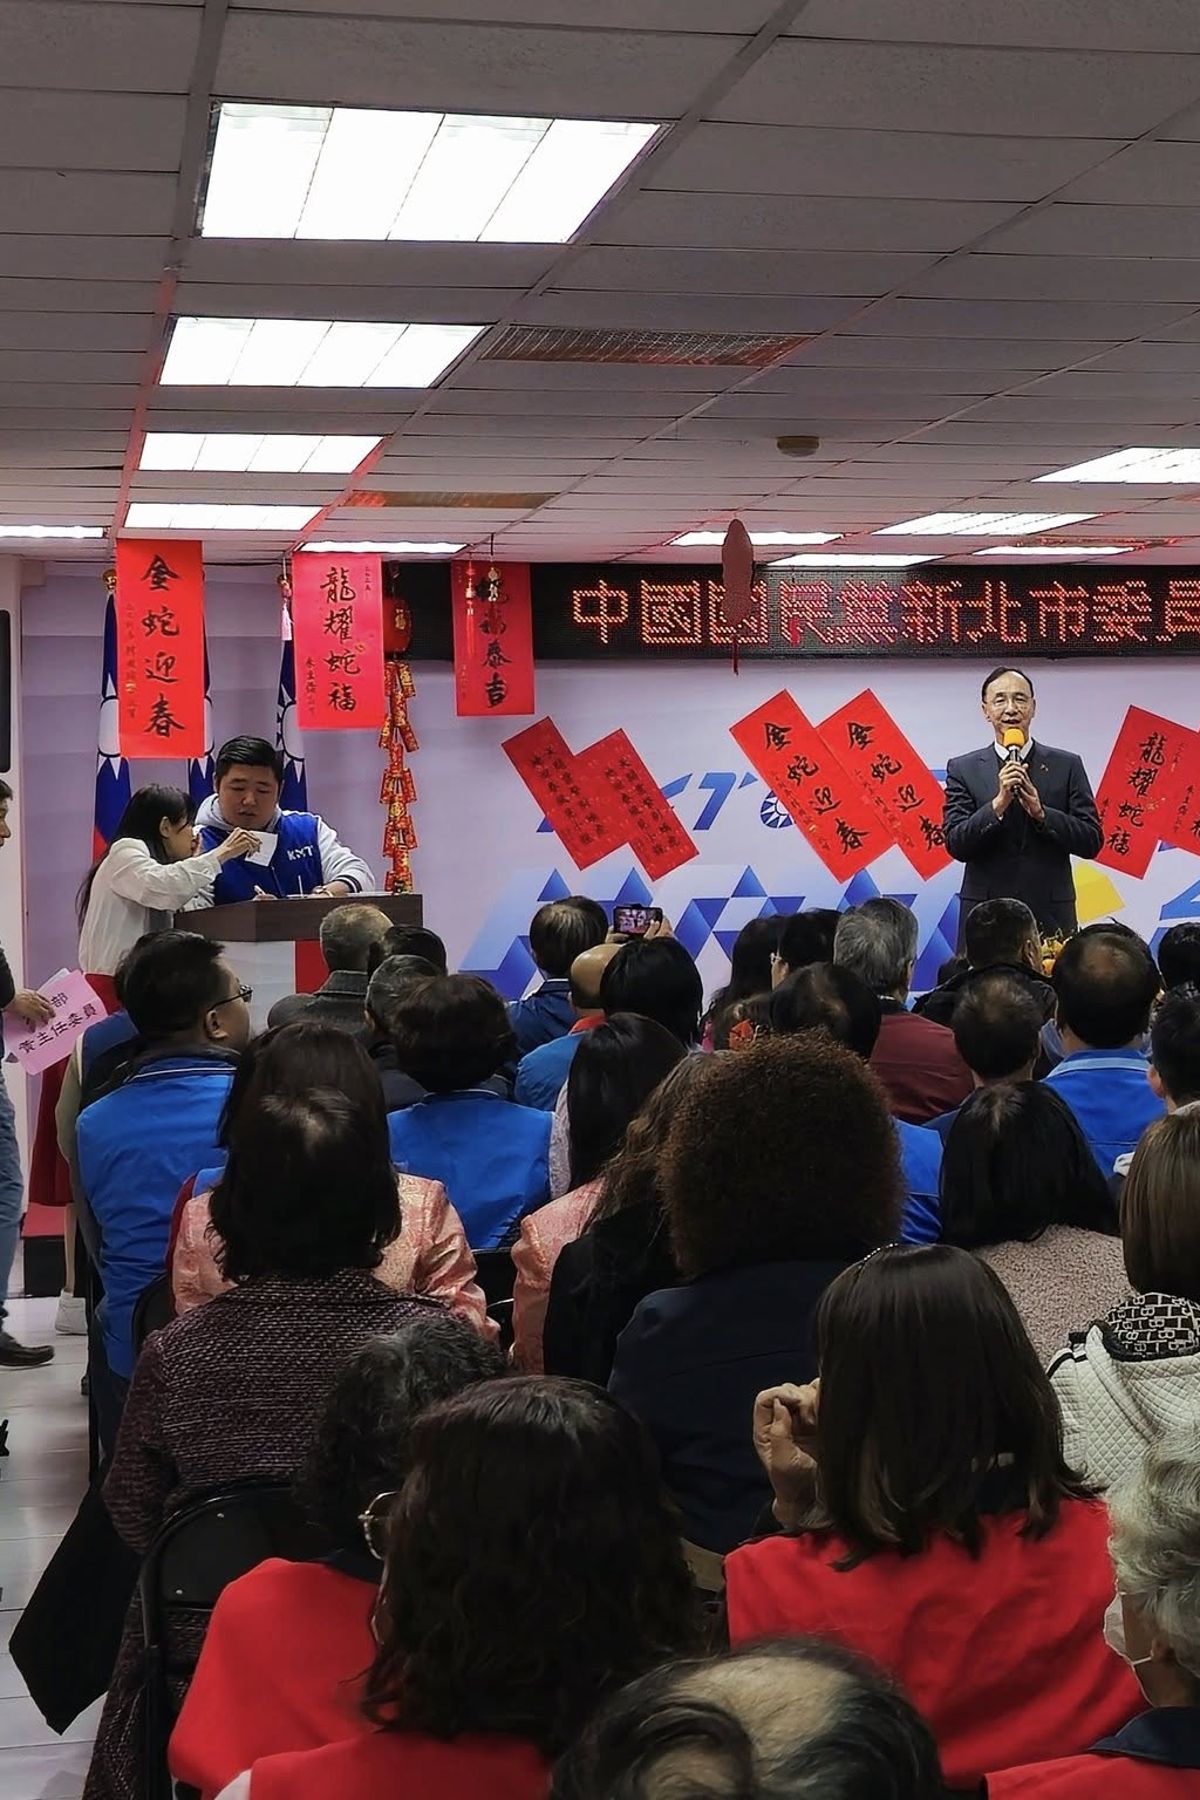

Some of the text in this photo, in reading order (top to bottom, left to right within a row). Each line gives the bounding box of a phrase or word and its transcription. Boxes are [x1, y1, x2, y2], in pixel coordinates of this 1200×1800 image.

[141, 554, 185, 738] 金蛇迎春
[763, 722, 871, 855] 金蛇迎春
